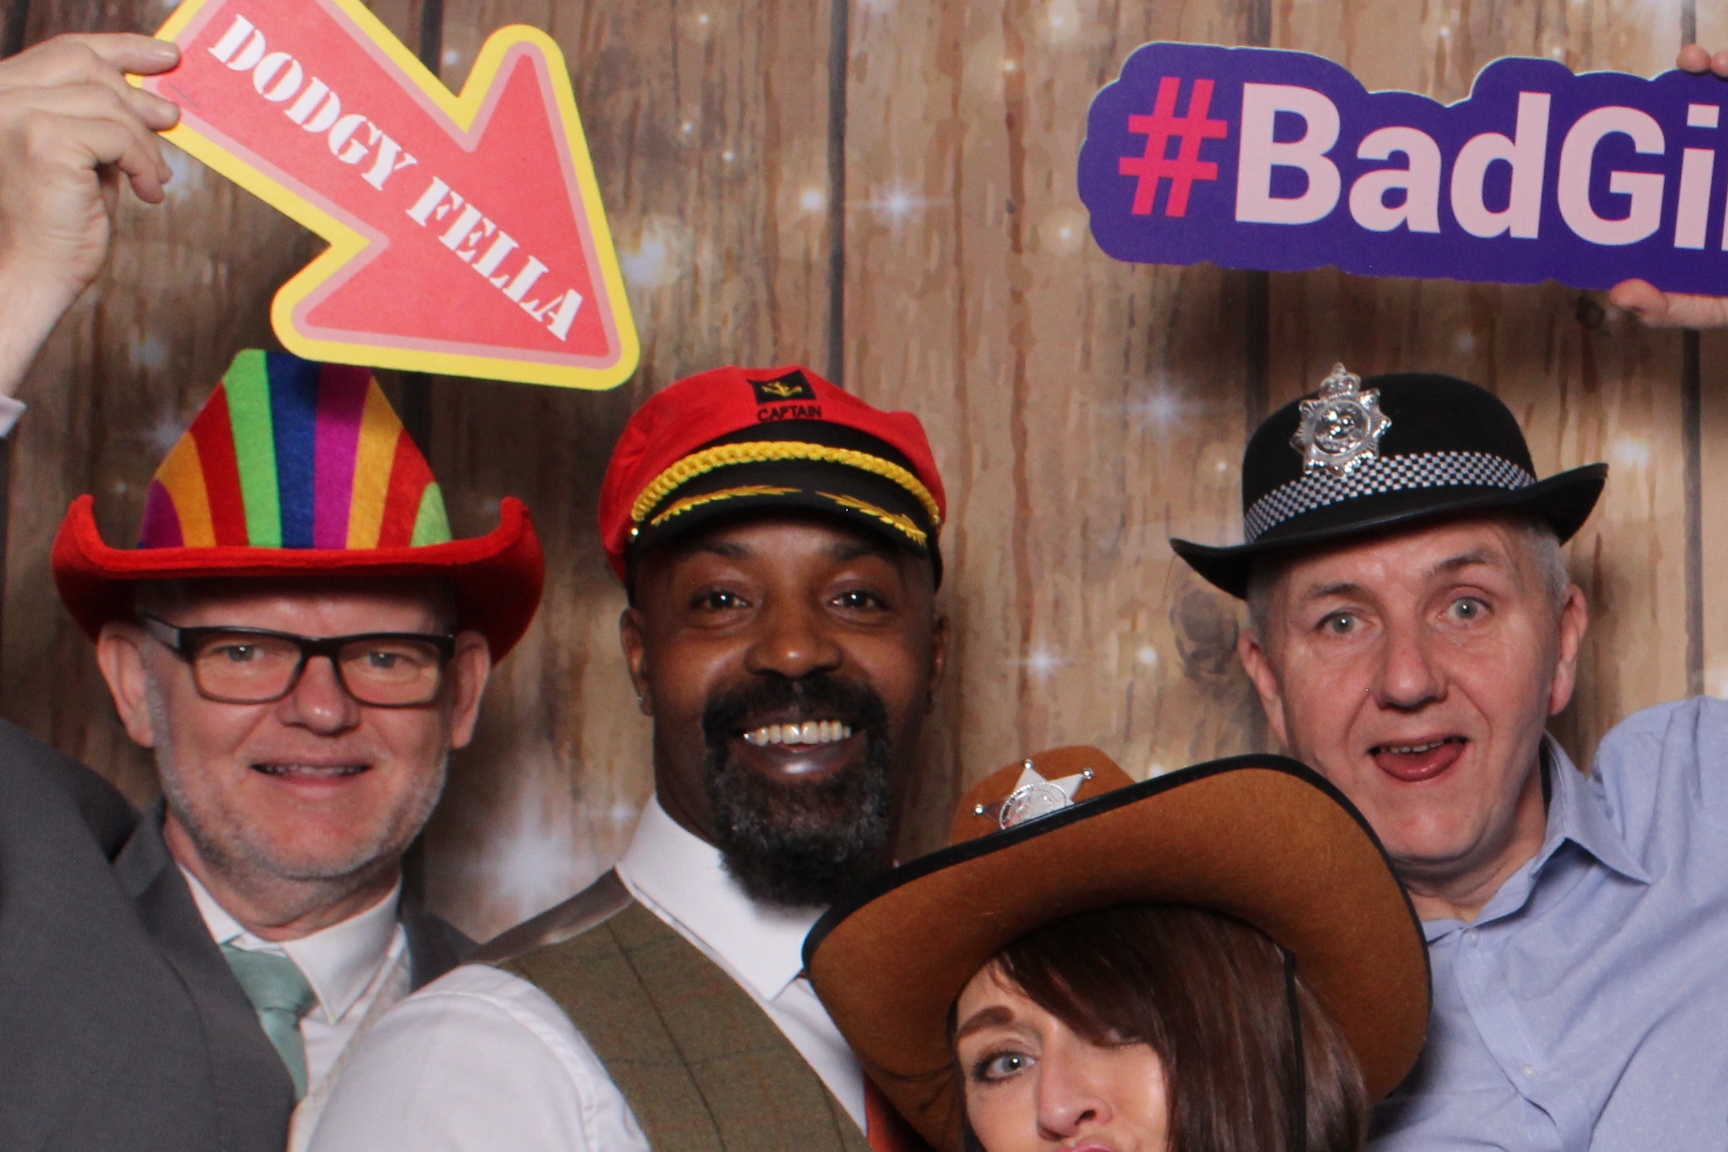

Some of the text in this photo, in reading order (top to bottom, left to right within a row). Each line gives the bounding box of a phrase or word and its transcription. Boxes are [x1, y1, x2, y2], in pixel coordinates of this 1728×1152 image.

[208, 15, 583, 343] DODGY FELLA
[757, 404, 822, 422] CAPTAIN
